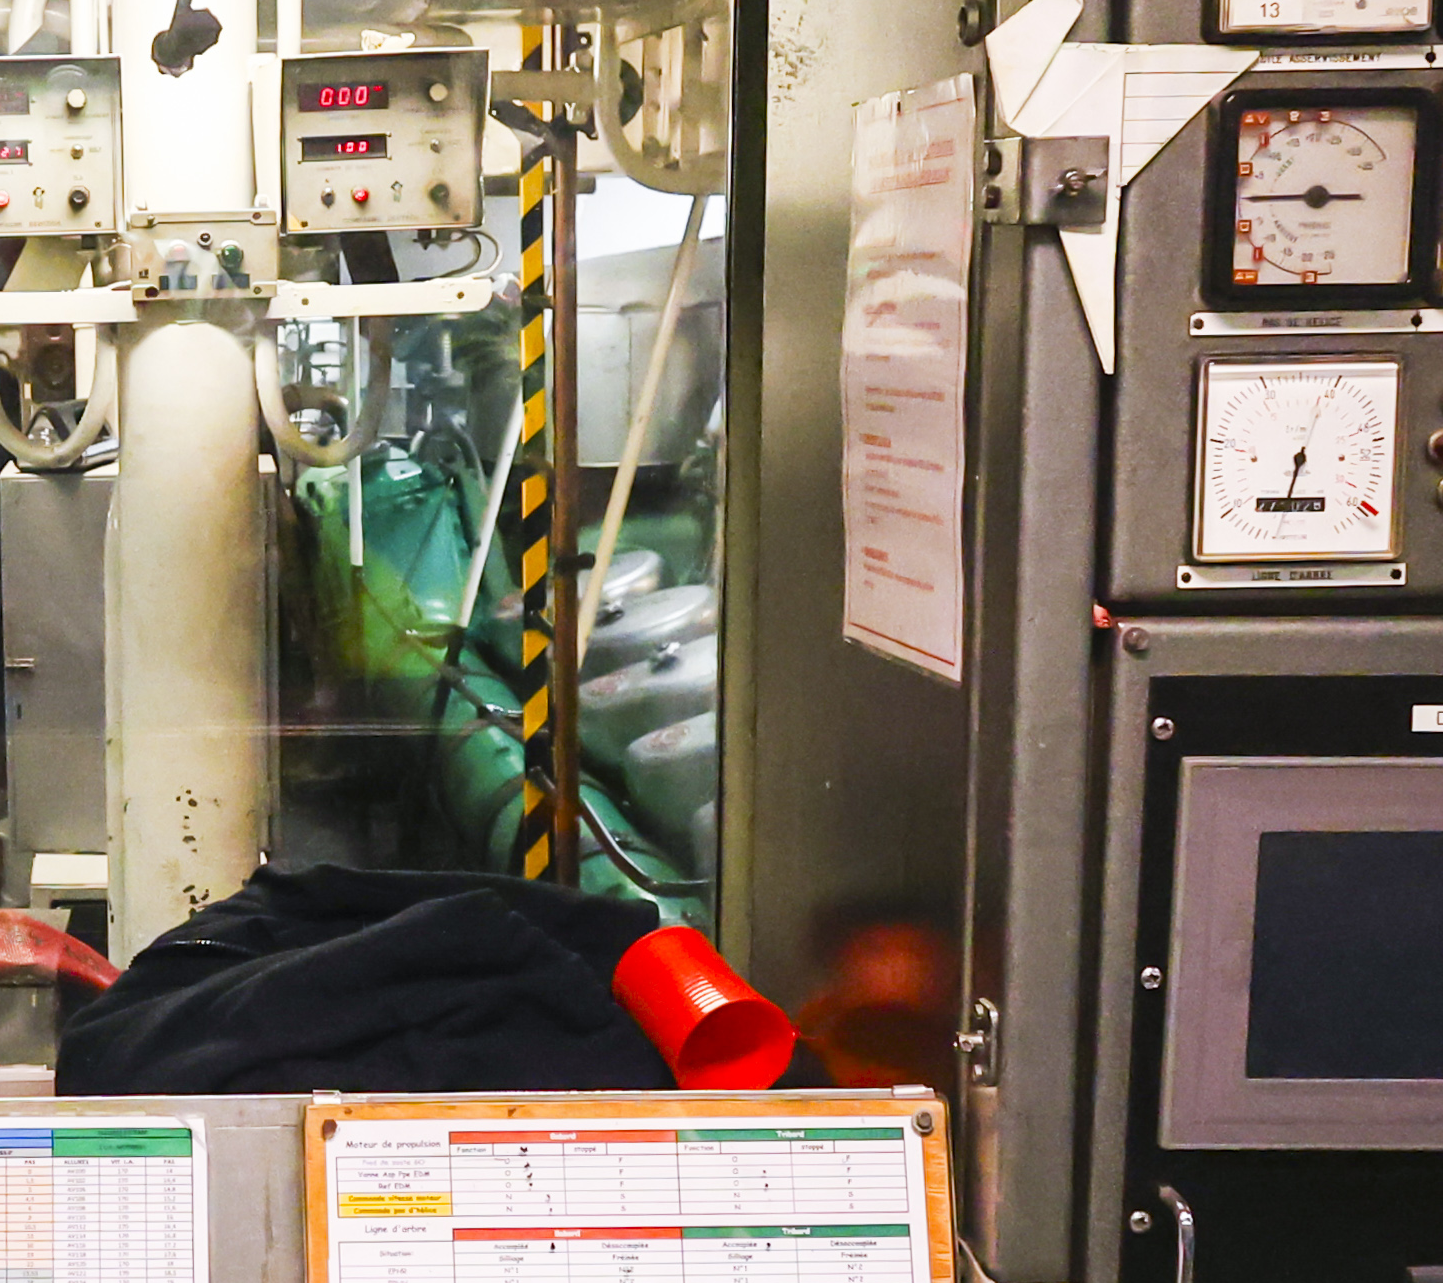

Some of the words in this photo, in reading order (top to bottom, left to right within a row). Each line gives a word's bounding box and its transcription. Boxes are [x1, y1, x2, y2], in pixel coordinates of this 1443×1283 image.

[1260, 2, 1281, 19] 13
[346, 1140, 377, 1150] Moteur
[381, 1140, 392, 1149] de
[395, 1139, 442, 1152] propulsion
